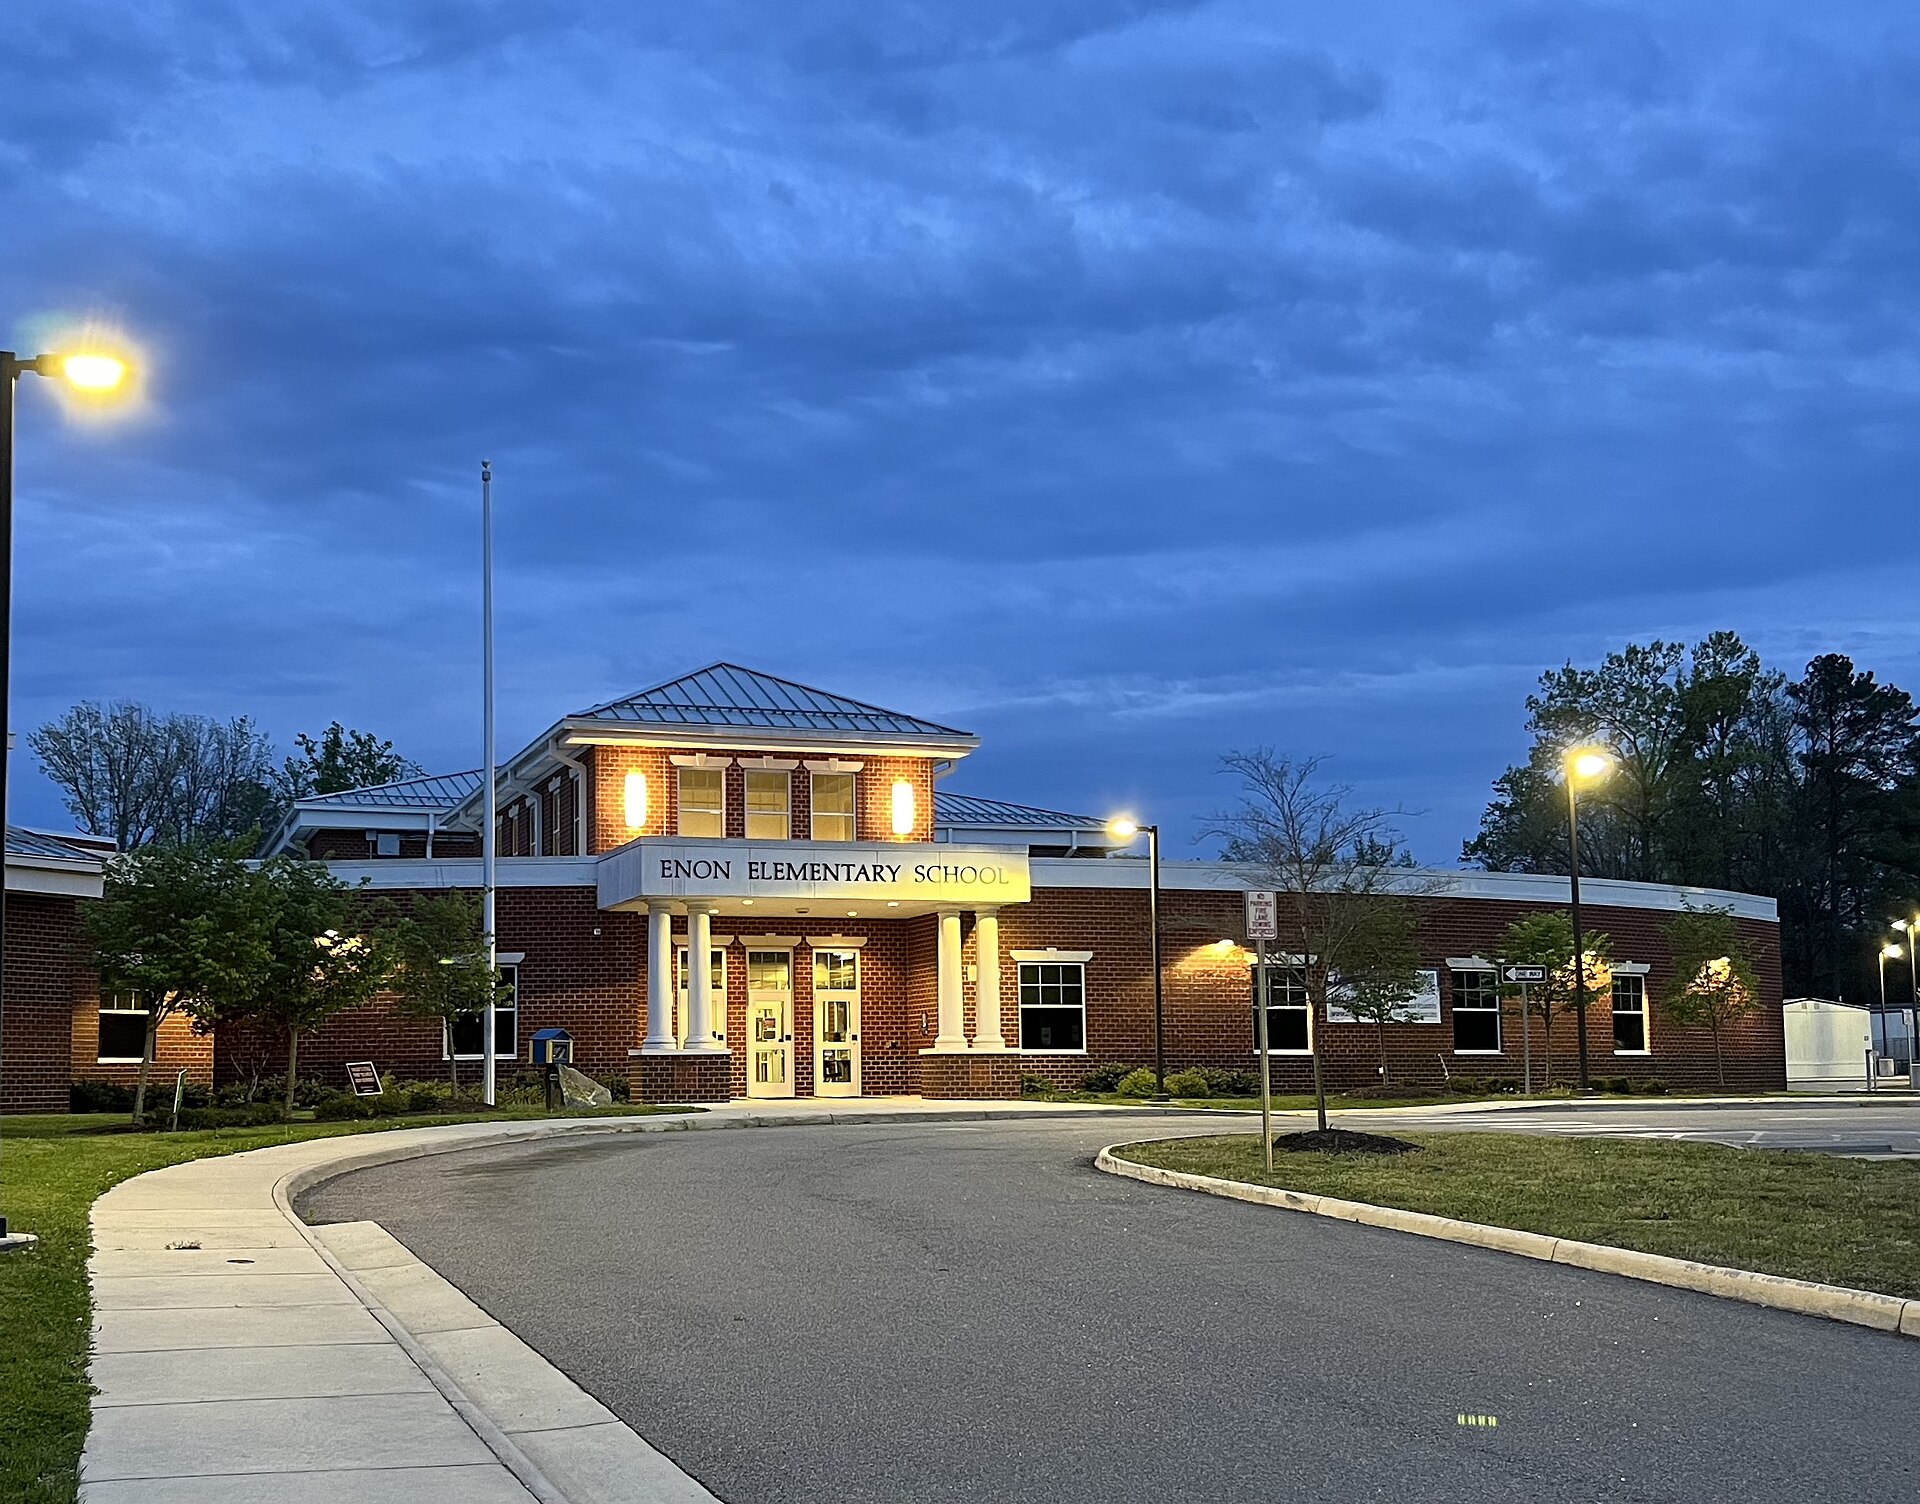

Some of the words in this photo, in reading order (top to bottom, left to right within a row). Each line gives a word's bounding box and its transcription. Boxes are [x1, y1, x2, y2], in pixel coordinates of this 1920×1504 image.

[660, 859, 731, 880] ENON
[748, 860, 902, 882] ELEMENTARY
[914, 864, 1010, 885] SCHOOL
